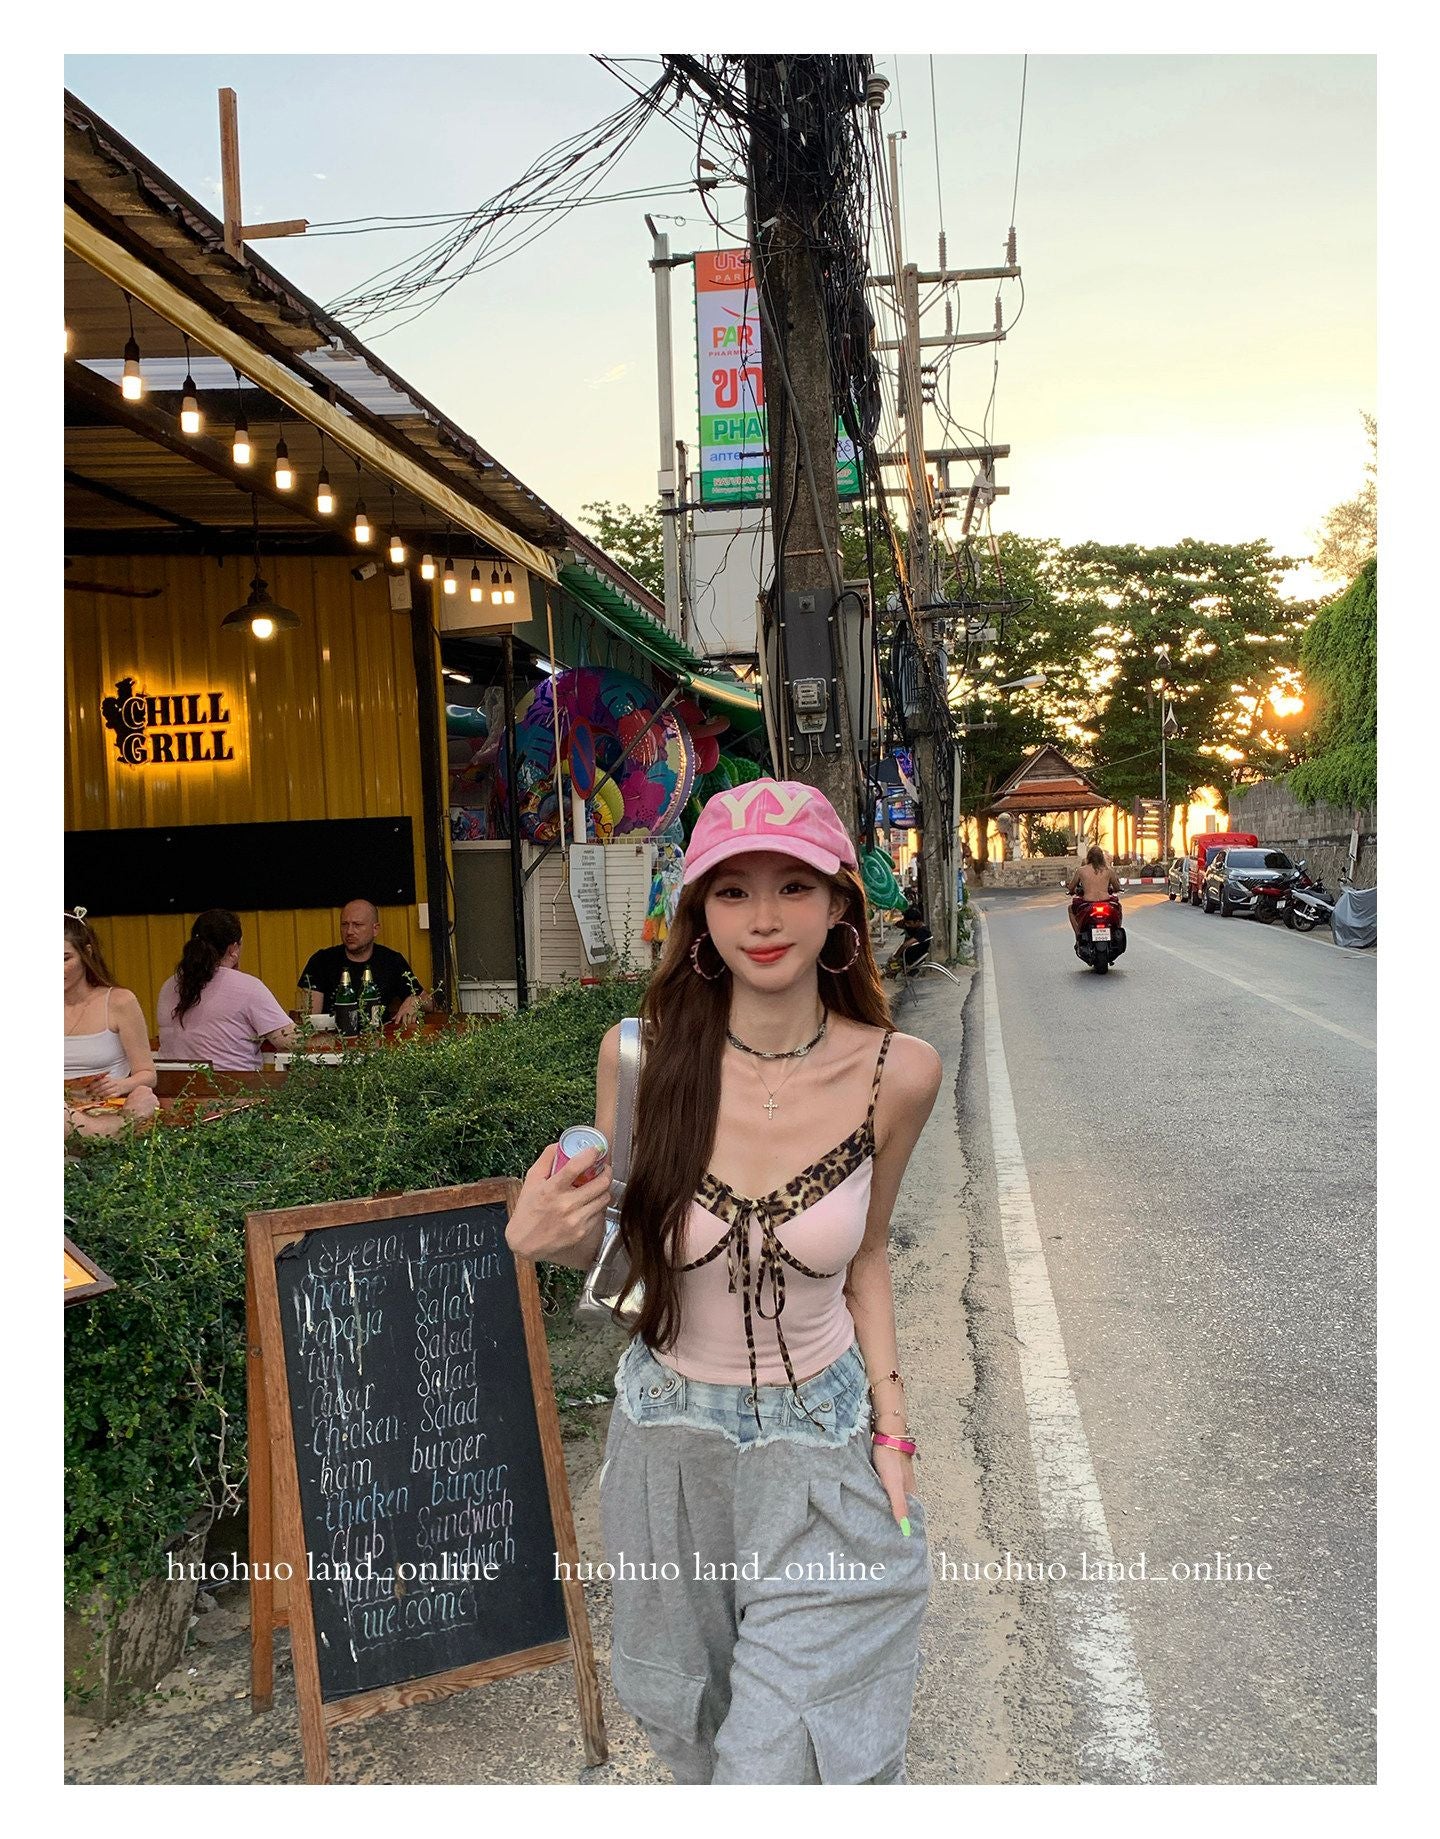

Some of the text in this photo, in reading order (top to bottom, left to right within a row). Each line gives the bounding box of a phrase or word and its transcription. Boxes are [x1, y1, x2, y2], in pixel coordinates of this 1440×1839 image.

[712, 325, 753, 348] PAR
[122, 693, 229, 729] CHILL
[122, 731, 233, 764] GRILL
[417, 1348, 478, 1397] Salad
[420, 1386, 479, 1432] Salad
[410, 1432, 487, 1475] burger
[431, 1463, 509, 1507] burger
